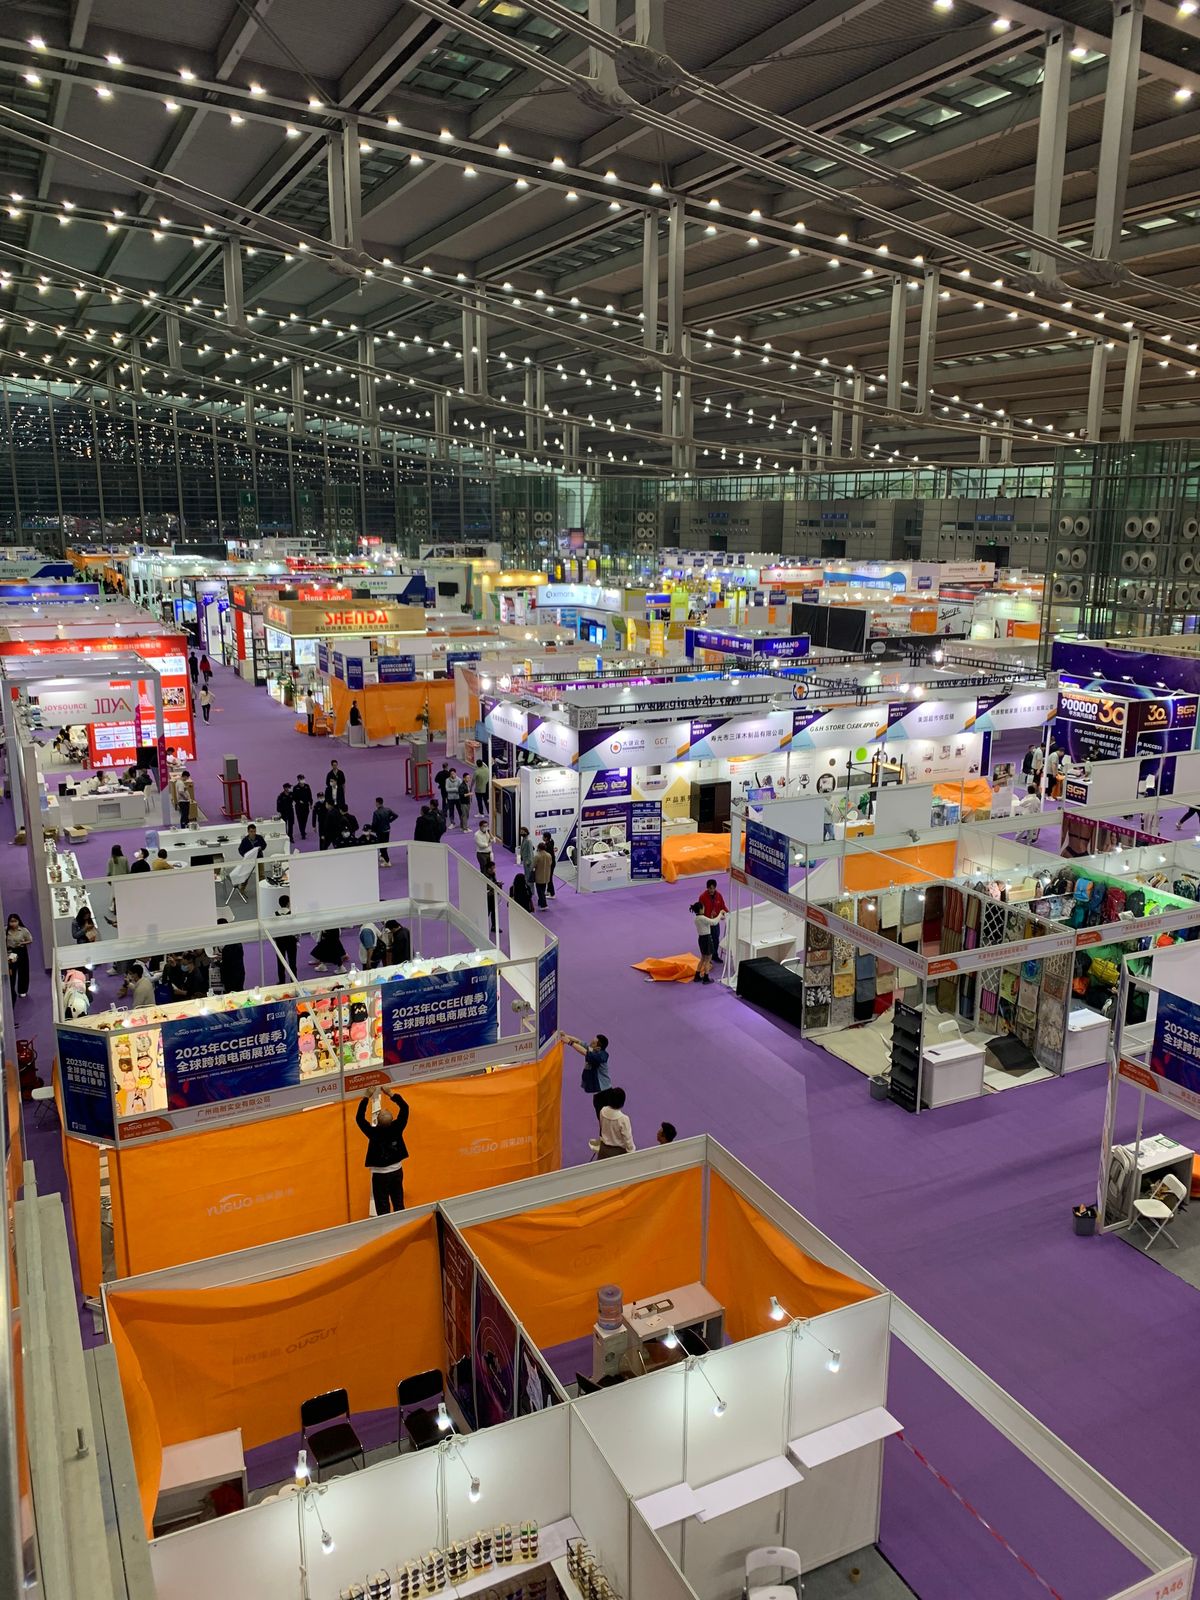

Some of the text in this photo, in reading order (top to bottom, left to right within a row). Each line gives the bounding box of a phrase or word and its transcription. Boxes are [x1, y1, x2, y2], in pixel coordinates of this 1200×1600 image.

[324, 609, 389, 626] SHENDA
[43, 702, 88, 712] JOYSOURCE
[637, 694, 742, 711] www.gigab2b.com
[1061, 698, 1098, 715] 900000
[1176, 704, 1197, 715] SGR
[654, 737, 668, 746] GCT
[1066, 783, 1086, 796] SGR
[391, 991, 488, 1019] 2023年CCEE(春季)
[392, 1004, 488, 1032] 全球跨境电商展览会
[1163, 1020, 1200, 1045] 2023年
[175, 1028, 287, 1060] 2023年CCEE(春季)
[65, 1057, 105, 1072] 2023年CCEE
[176, 1042, 288, 1073] 全球跨境电商展览会
[316, 1082, 338, 1095] 1A48
[1155, 1578, 1184, 1600] 1A46
